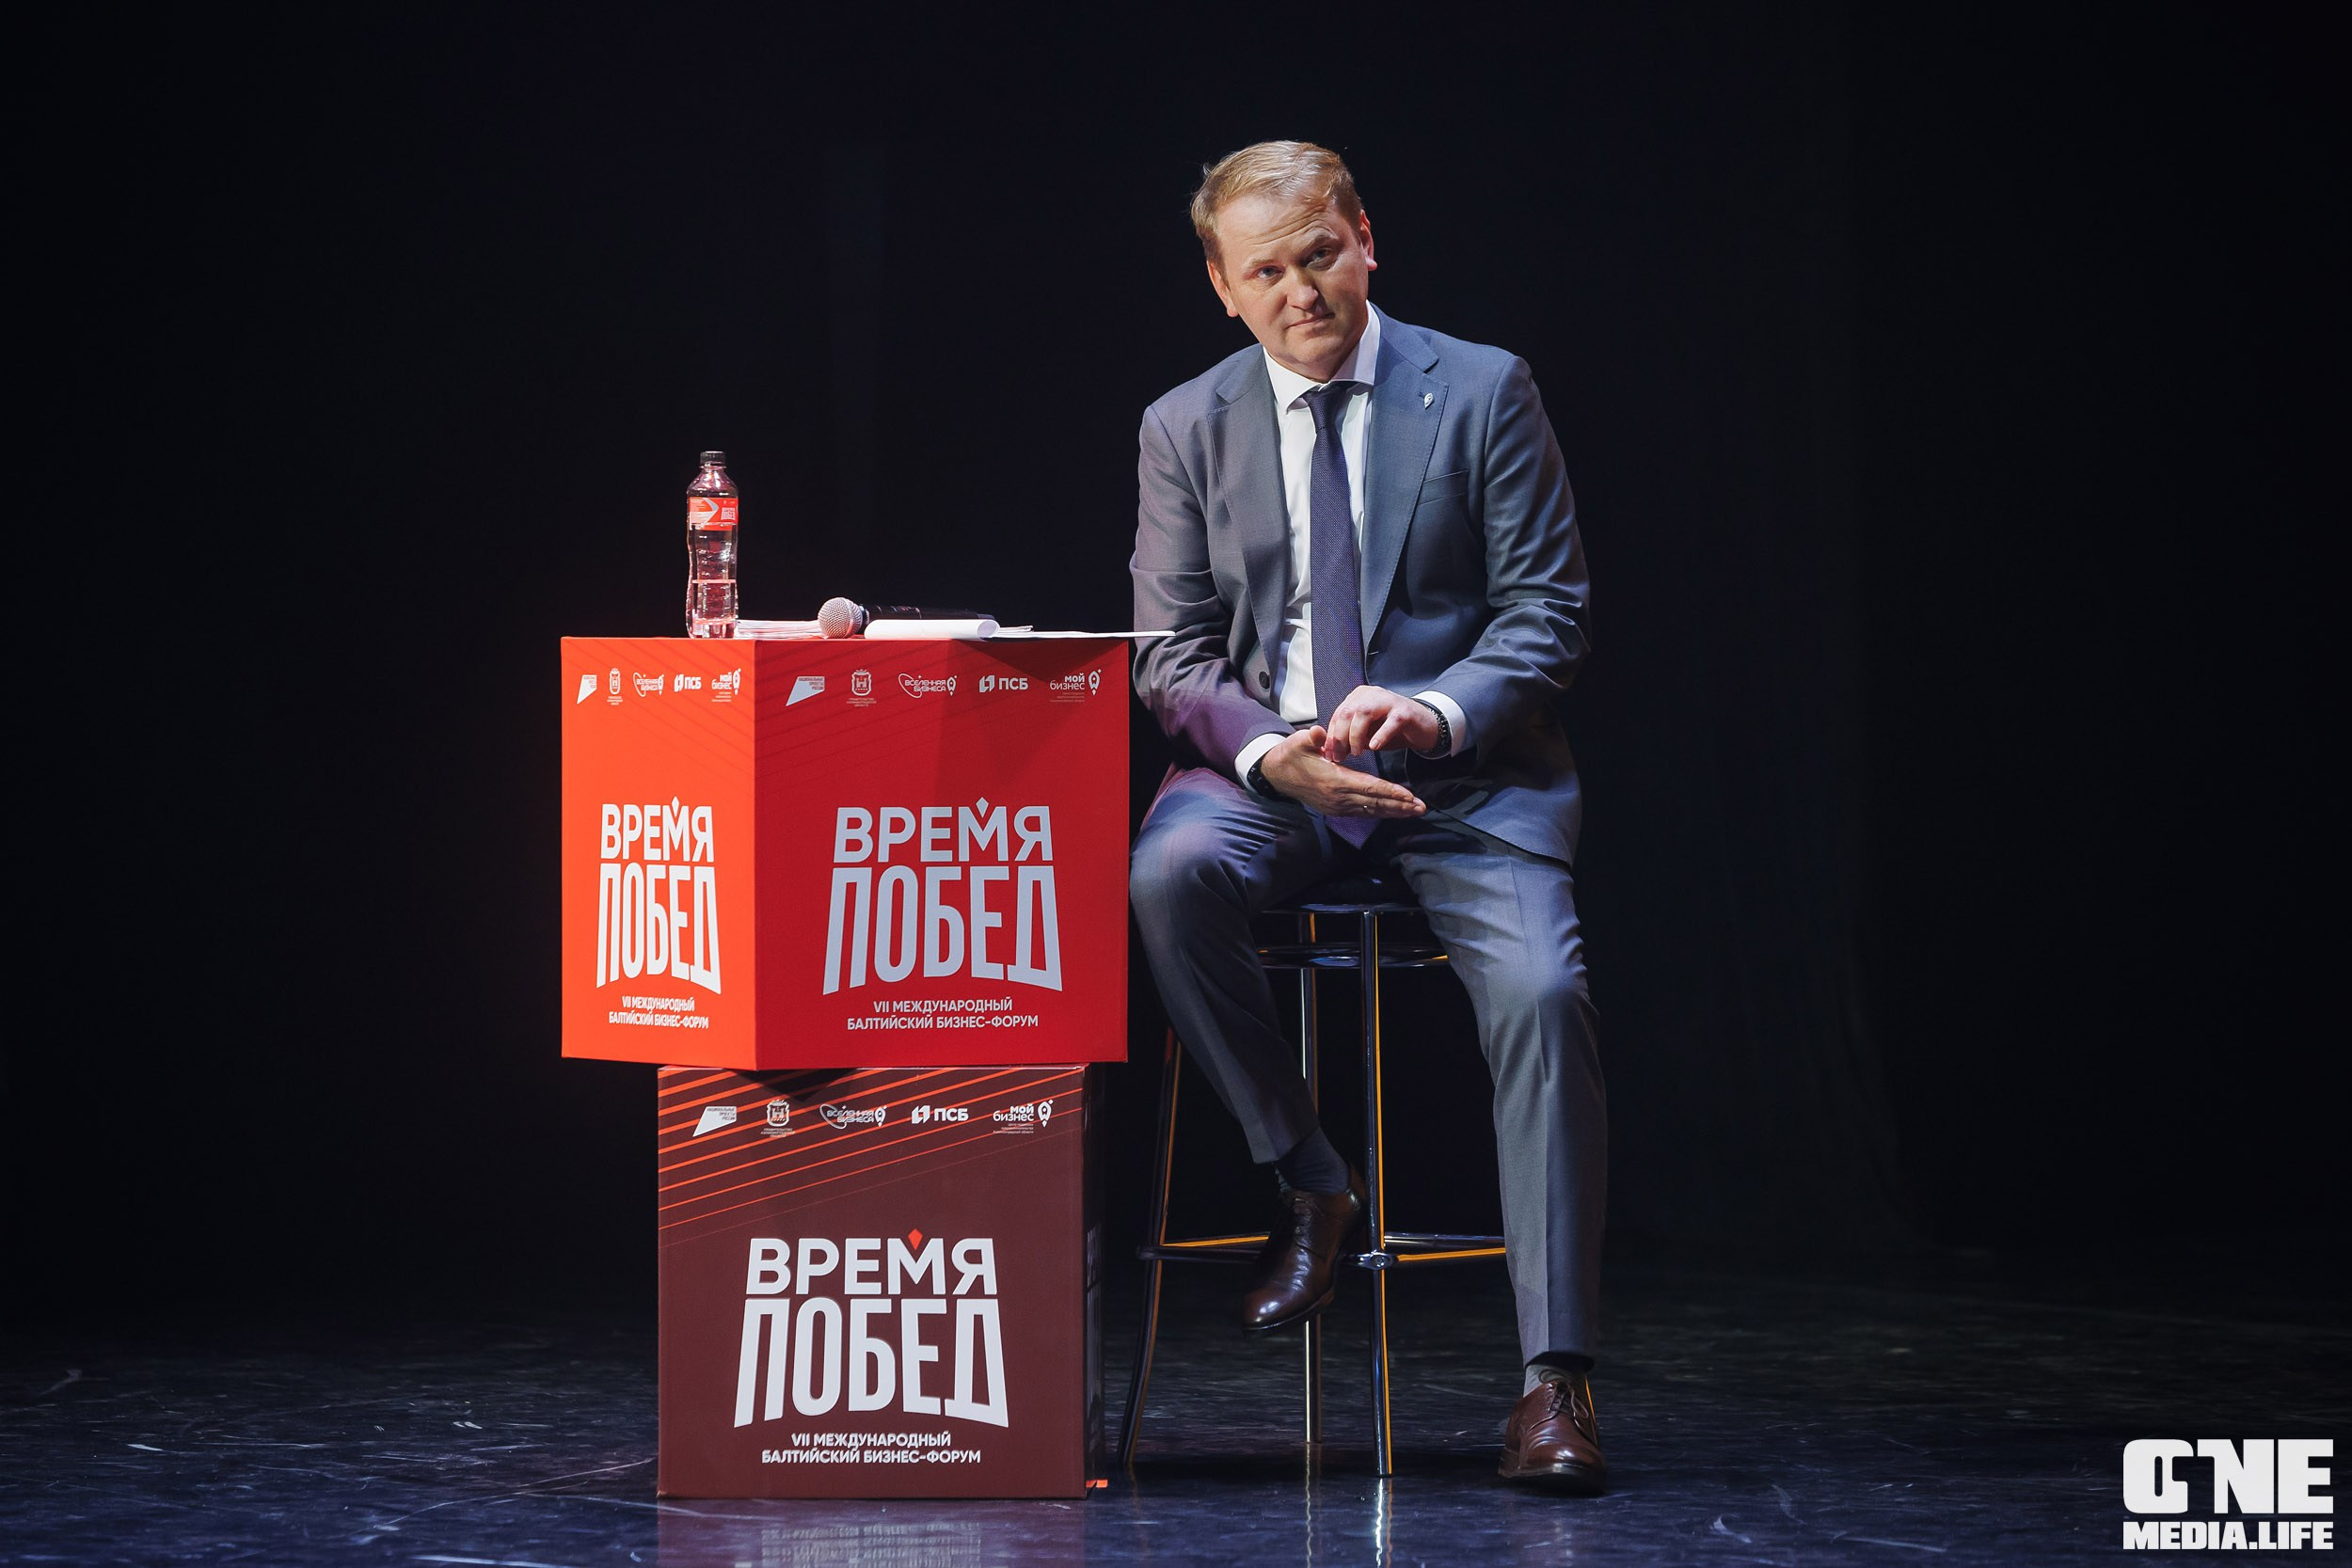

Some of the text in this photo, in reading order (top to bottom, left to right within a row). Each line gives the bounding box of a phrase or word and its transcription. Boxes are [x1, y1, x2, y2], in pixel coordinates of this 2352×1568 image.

[685, 676, 702, 689] ПСБ
[999, 677, 1029, 690] ПСБ
[1049, 679, 1086, 690] бизнес
[1065, 673, 1085, 683] мой
[601, 803, 714, 863] ВРЕМЯ
[834, 806, 1054, 863] ВРЕМЯ
[596, 863, 722, 995] ПОБЕД
[823, 864, 1063, 996] ПОБЕД
[632, 996, 695, 1012] МЕЖДУНАРОДНЫЙ
[873, 996, 1013, 1016] VII МЕЖДУНАРОДНЫЙ
[609, 1010, 709, 1029] БАЛТИЙСКИЙ БИЗНЕС-ФОРУМ
[847, 1014, 1039, 1030] БАЛТИЙСКИЙ БИЗНЕС-ФОРУМ
[934, 1108, 969, 1121] ПСБ
[993, 1110, 1035, 1122] бизнес
[1010, 1104, 1034, 1114] мой
[746, 1238, 998, 1295] ВРЕМЯ
[734, 1297, 1009, 1428] ПОБЕД
[791, 1431, 951, 1449] VII МЕЖДУНАРОДНЫЙ
[761, 1447, 981, 1464] БАЛТИЙСКИЙ БИЗНЕС-ФОРУМ
